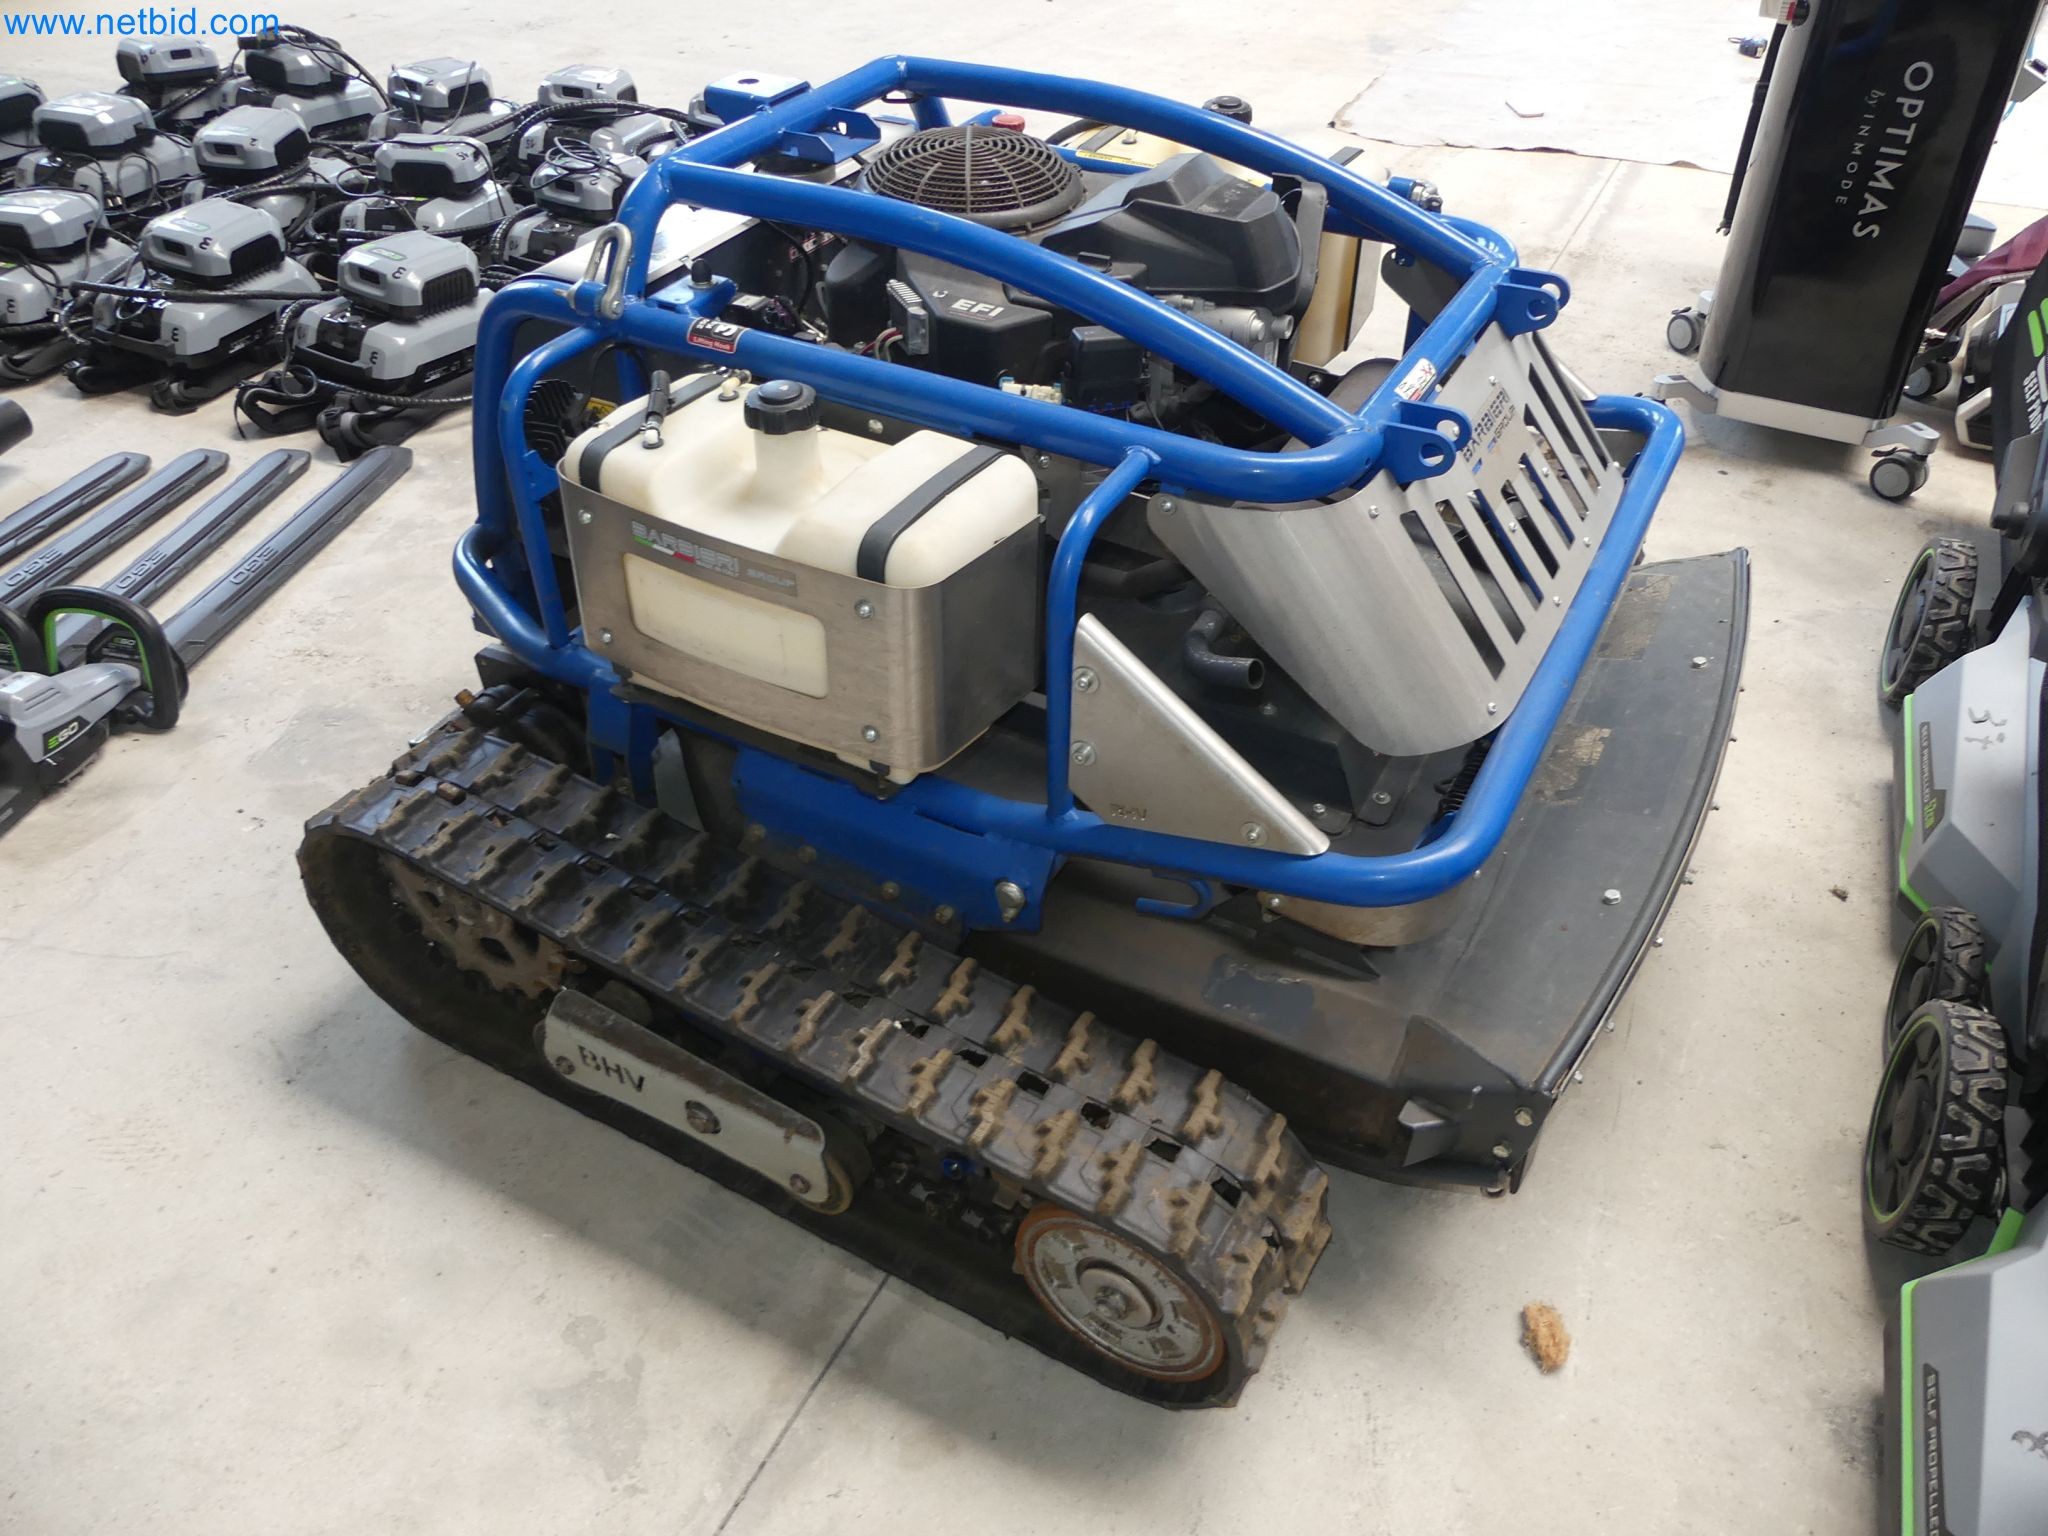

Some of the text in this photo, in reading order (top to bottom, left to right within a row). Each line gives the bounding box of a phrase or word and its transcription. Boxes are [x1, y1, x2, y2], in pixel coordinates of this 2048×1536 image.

[1835, 89, 1886, 205] by INMODE
[1852, 61, 1934, 239] OPTIMAS
[951, 298, 1004, 317] EFI
[229, 546, 279, 585] EGO
[631, 520, 740, 572] BARBIERI
[47, 720, 80, 750] EGO
[1921, 725, 1931, 803] SELF PROPELLED
[577, 1045, 645, 1093] BHV
[1926, 1374, 1938, 1420] SELF
